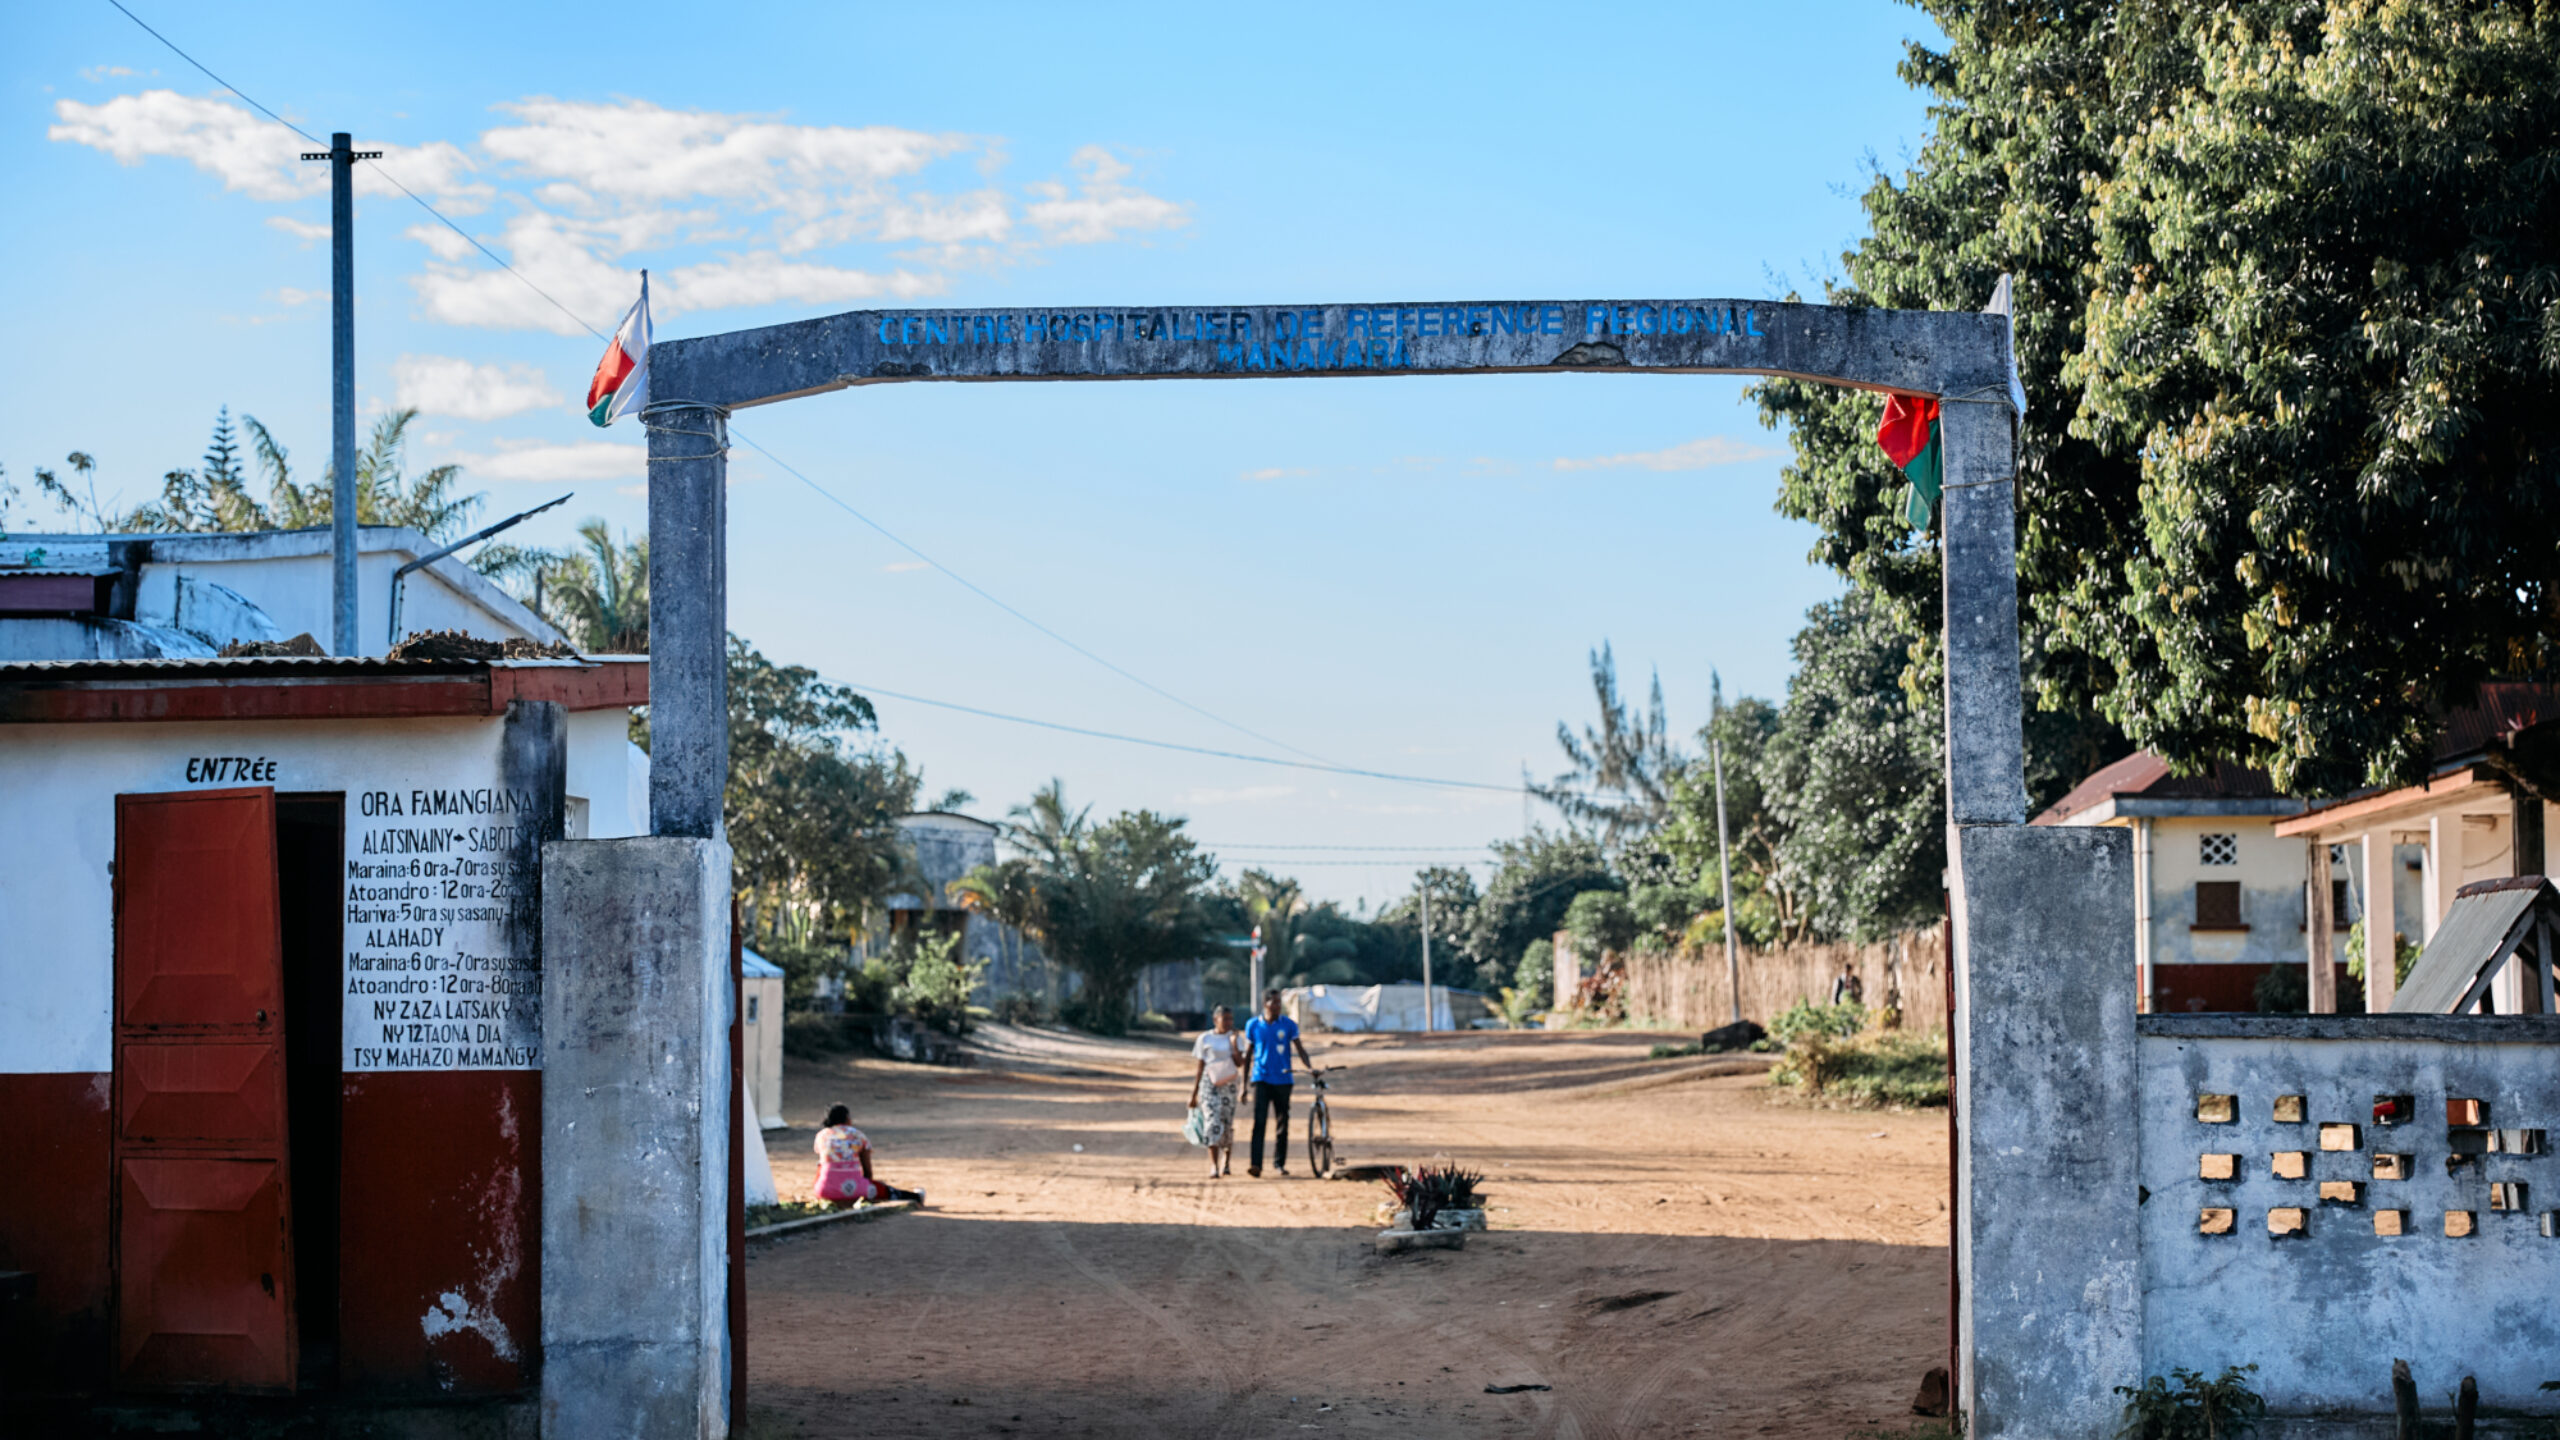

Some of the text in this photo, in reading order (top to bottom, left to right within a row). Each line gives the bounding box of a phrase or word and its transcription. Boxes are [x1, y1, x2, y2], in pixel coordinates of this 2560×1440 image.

[879, 304, 1766, 345] CENTRE HOSPITALIER DE REFERENCE REGIONAL
[1218, 338, 1412, 370] MANAKARA
[186, 756, 278, 783] ENTRÉE
[361, 788, 534, 816] ORA FAMANGIANA
[362, 828, 454, 855] ALATSINAINY
[365, 927, 445, 948] ALAHADY
[374, 1000, 513, 1020] NY ZAZA LATSAKY
[383, 1023, 404, 1044] NY
[477, 1023, 502, 1044] DIA
[354, 1047, 537, 1068] TSY MAHAZO MAMANGY
